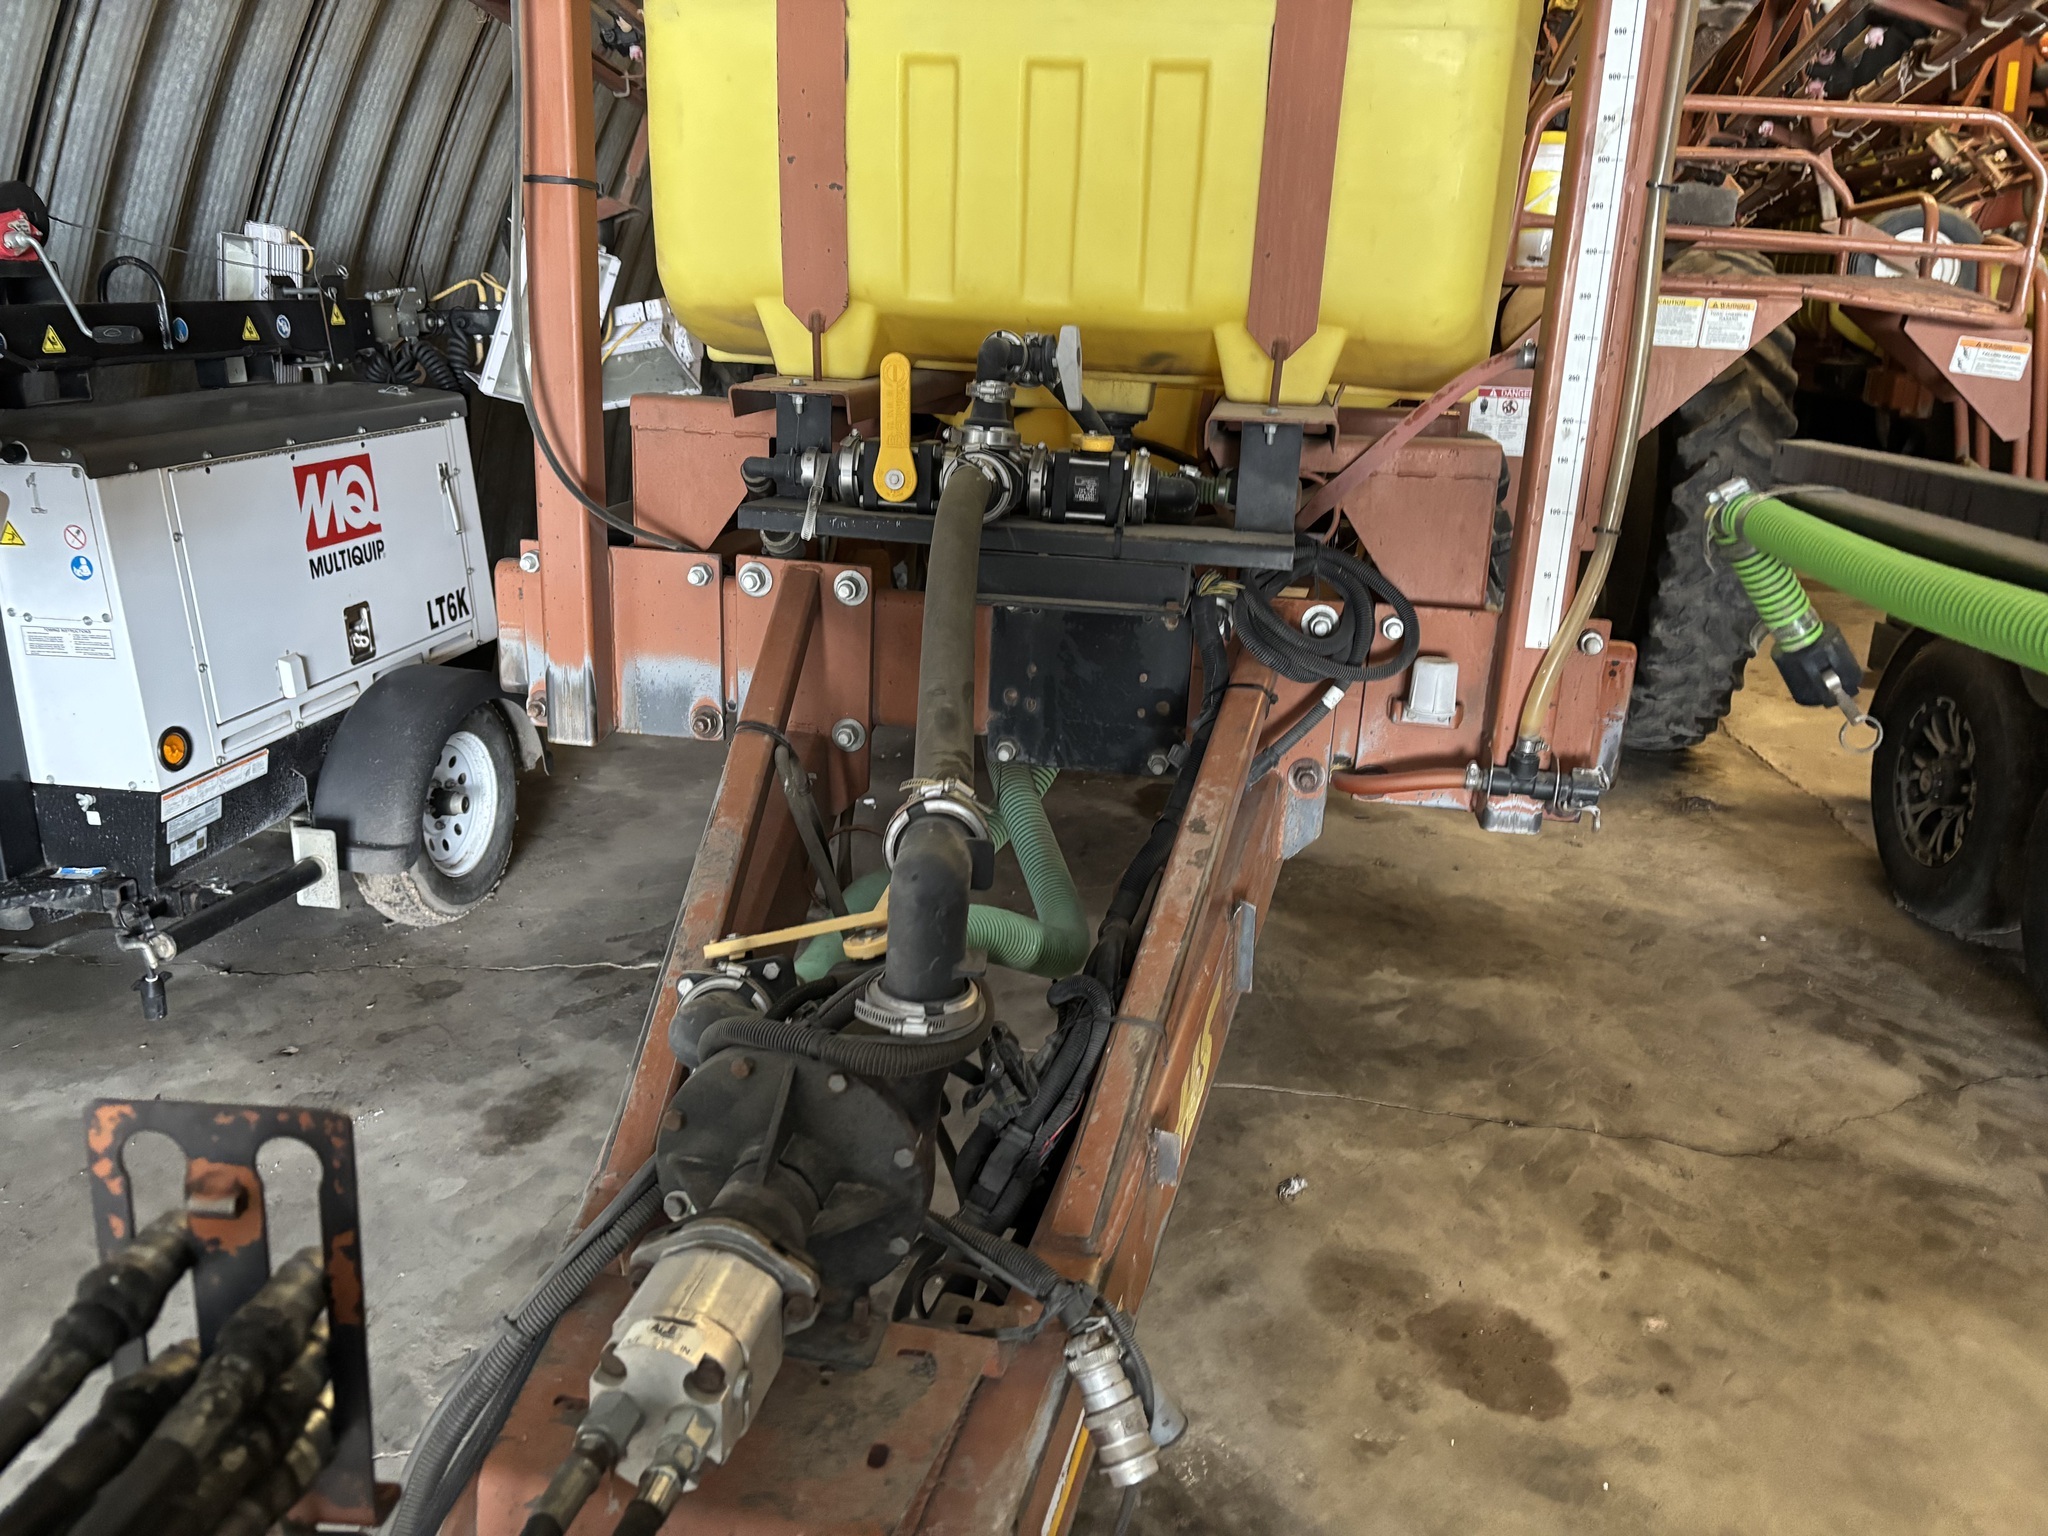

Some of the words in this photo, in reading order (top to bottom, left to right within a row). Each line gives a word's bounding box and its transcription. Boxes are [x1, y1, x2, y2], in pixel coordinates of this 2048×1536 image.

[1720, 302, 1751, 310] WARNING
[1501, 388, 1531, 398] DANGE
[300, 464, 382, 540] MQ
[1550, 507, 1561, 516] 100
[309, 539, 385, 580] MULTIQUIP
[427, 587, 470, 631] LT6K
[680, 1344, 691, 1356] IN
